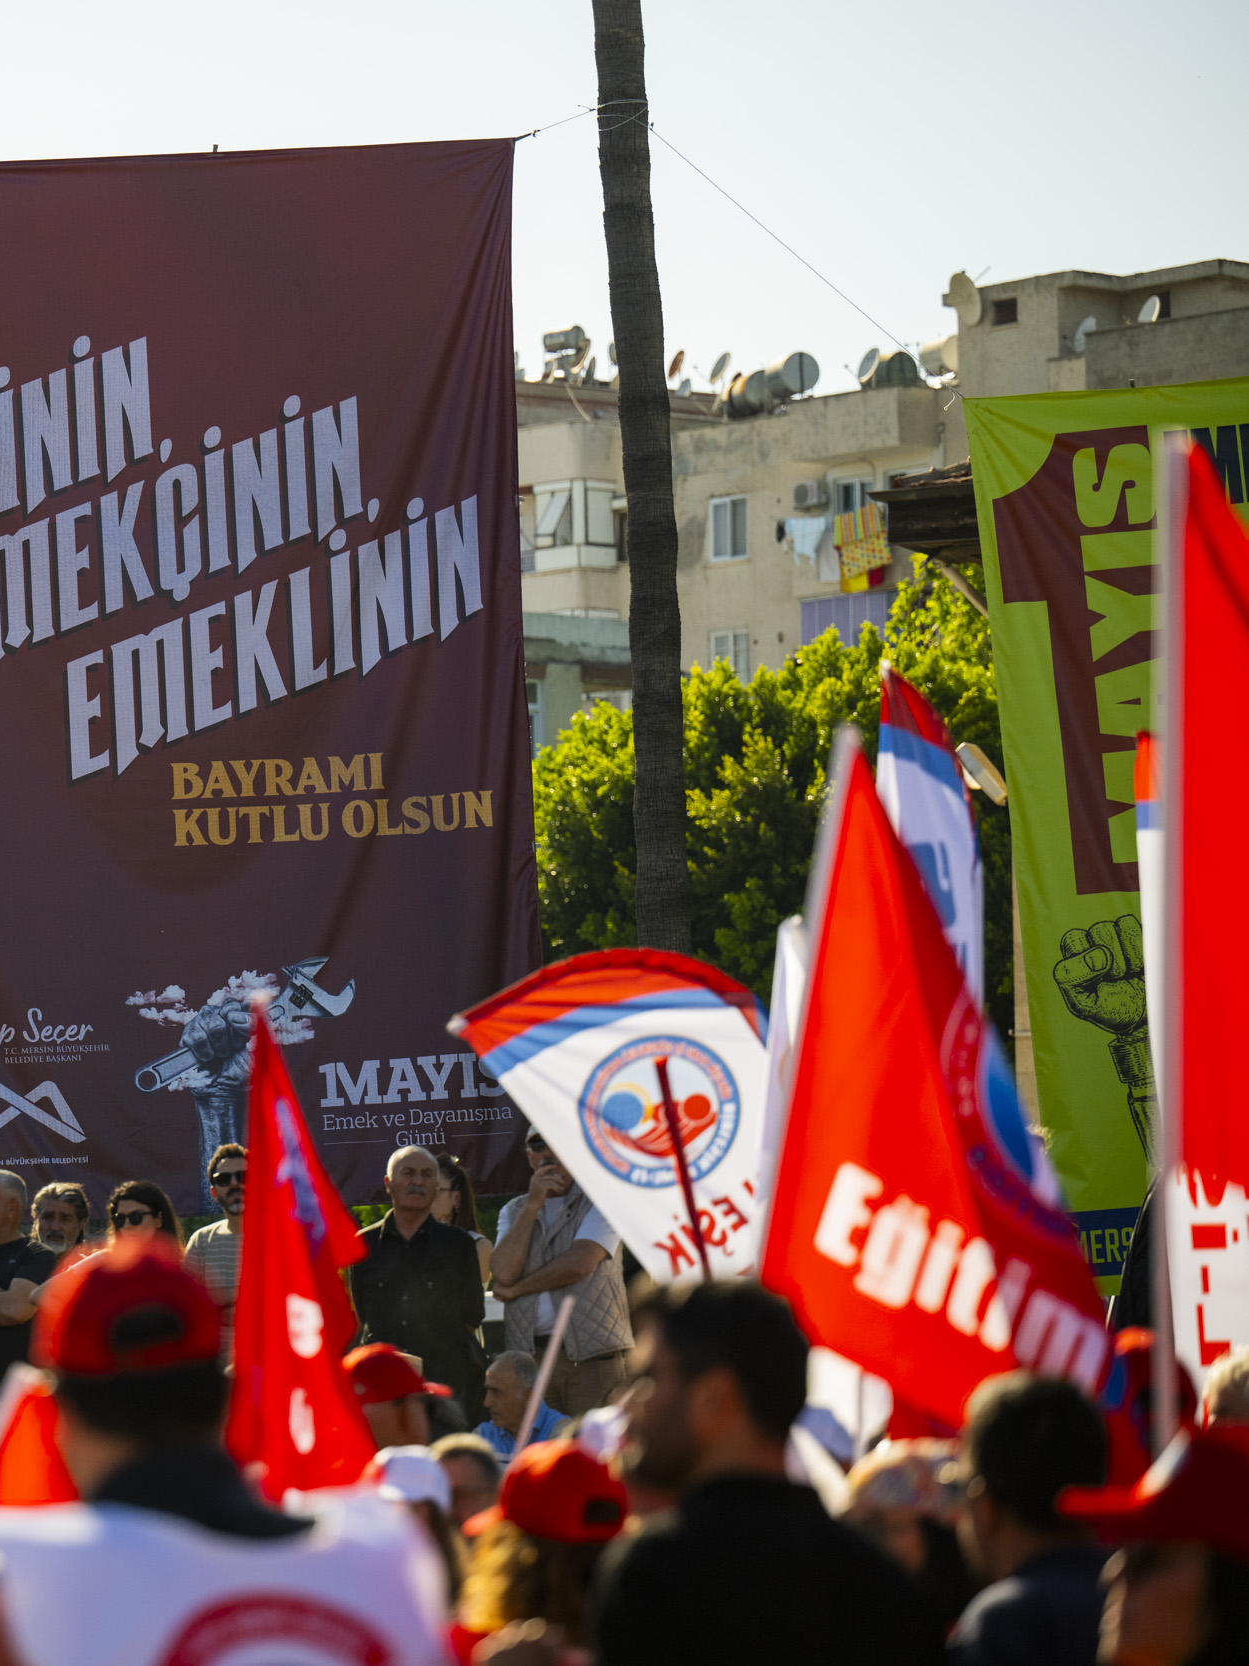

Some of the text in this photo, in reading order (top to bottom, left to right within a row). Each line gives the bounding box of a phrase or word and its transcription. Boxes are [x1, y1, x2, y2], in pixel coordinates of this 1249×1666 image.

[66, 494, 484, 781] EMEKLİNİN
[170, 752, 385, 800] BAYRAMI
[172, 790, 494, 847] KUTLU OLSUN
[22, 1007, 94, 1044] Seçer
[4, 1054, 82, 1064] BELEDİYE BAŞKANI
[21, 1045, 54, 1055] MERSİN
[56, 1043, 111, 1054] BÜYÜKŞEHİR
[323, 1106, 513, 1131] Emek ve Dayanışma
[395, 1128, 447, 1147] Günü
[5, 1156, 50, 1166] BÜYÜKŞEHİR
[51, 1155, 89, 1164] BELEDİYESİ
